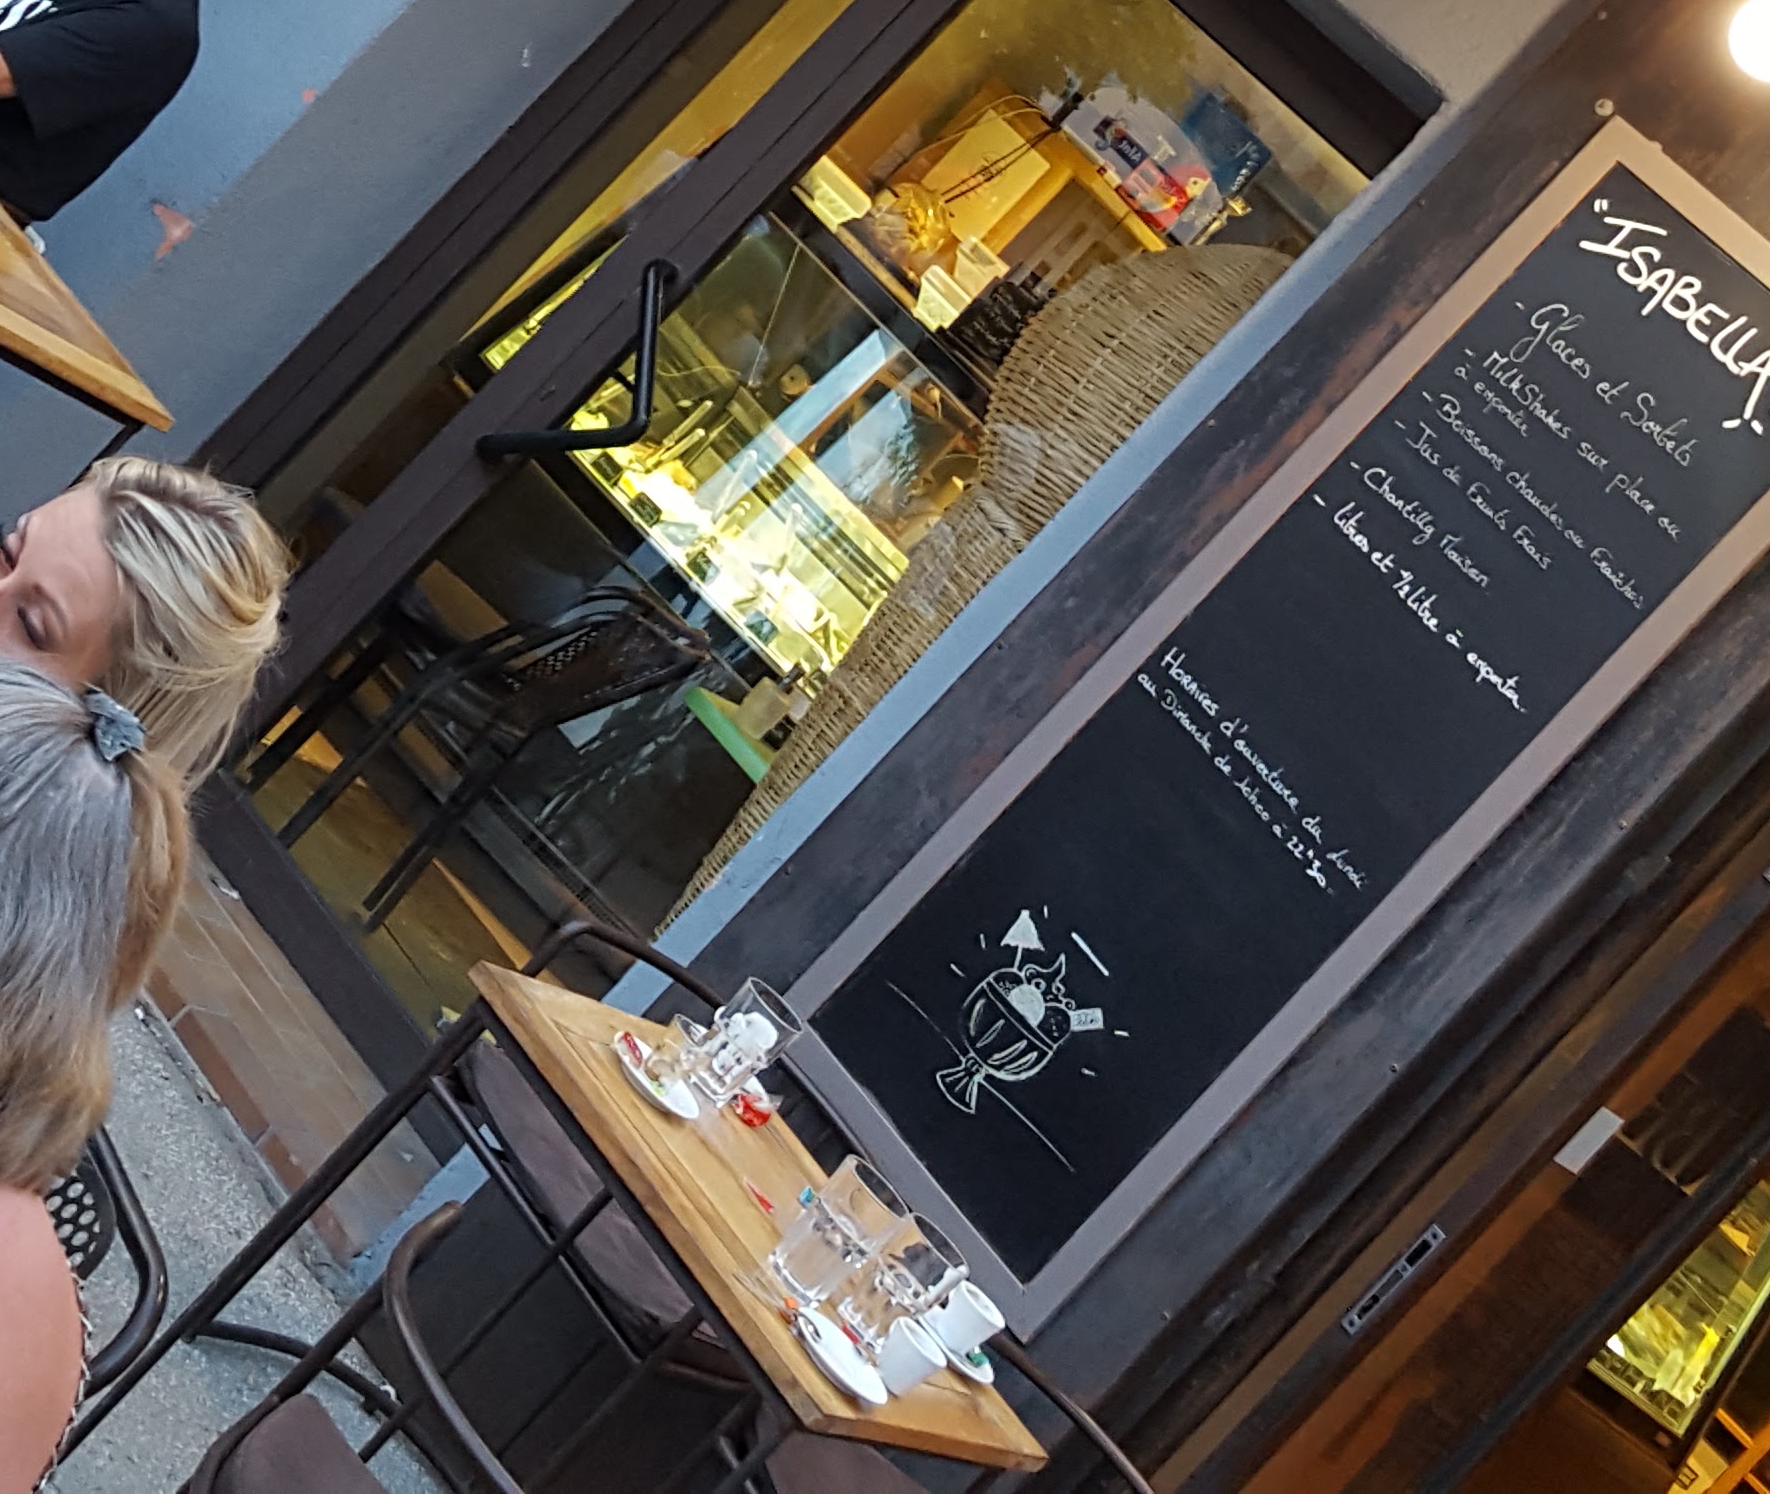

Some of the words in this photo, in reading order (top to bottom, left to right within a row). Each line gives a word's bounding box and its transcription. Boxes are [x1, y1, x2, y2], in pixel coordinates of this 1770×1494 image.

[1509, 303, 1592, 380] Glaces
[1595, 380, 1630, 405] et
[1619, 392, 1699, 467] Sorbets
[1363, 467, 1436, 546] Chantilly
[1439, 534, 1490, 588] Maison
[1405, 420, 1441, 467] Jus
[1442, 465, 1461, 488] de
[1512, 524, 1554, 571] Frais
[1436, 393, 1505, 473] Boissons
[1505, 471, 1565, 532] chaudes
[1563, 528, 1585, 550] ou
[1577, 441, 1609, 474] sur
[1657, 515, 1682, 543] ou
[1370, 550, 1396, 574] et
[1137, 672, 1158, 699] au
[1213, 754, 1232, 777] de
[1301, 815, 1323, 845] du
